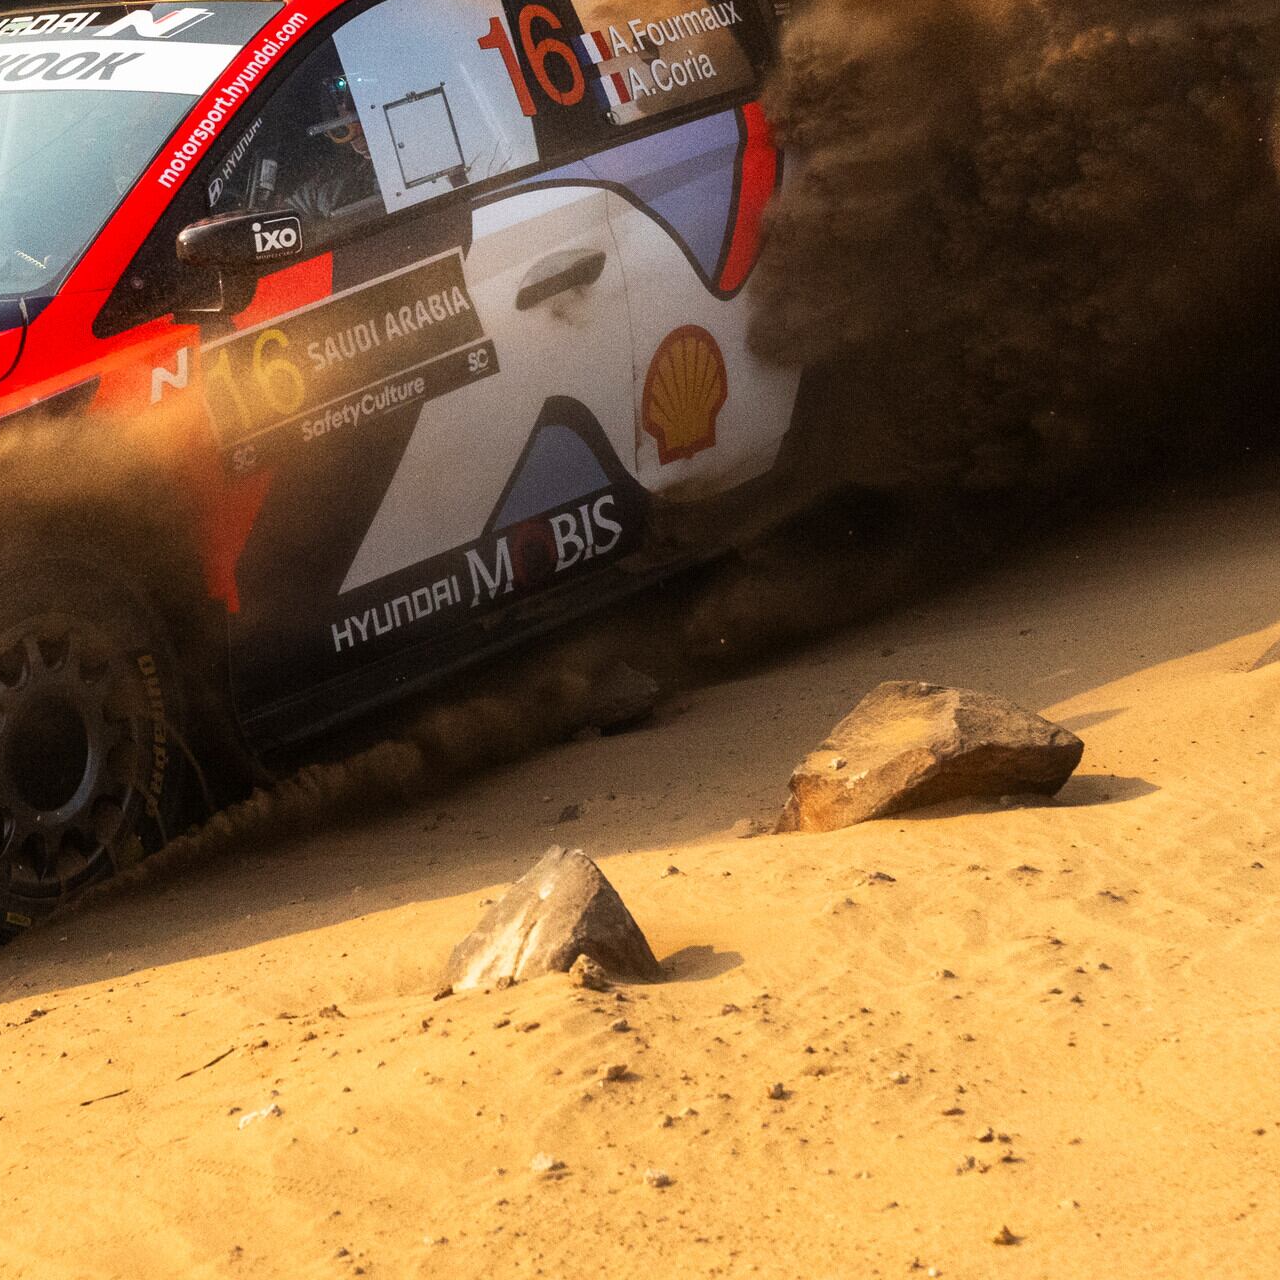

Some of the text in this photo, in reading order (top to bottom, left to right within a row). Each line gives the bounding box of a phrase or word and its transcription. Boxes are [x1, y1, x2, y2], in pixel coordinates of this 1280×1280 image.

[477, 4, 585, 117] 16
[608, 1, 742, 57] A.Fourmaux
[158, 12, 308, 188] motorsport.hyundai.com
[628, 50, 717, 100] A.Coria
[307, 286, 471, 371] SAUDI ARABIA
[301, 377, 425, 442] SafetyCulture
[331, 574, 462, 653] HYUNDAI
